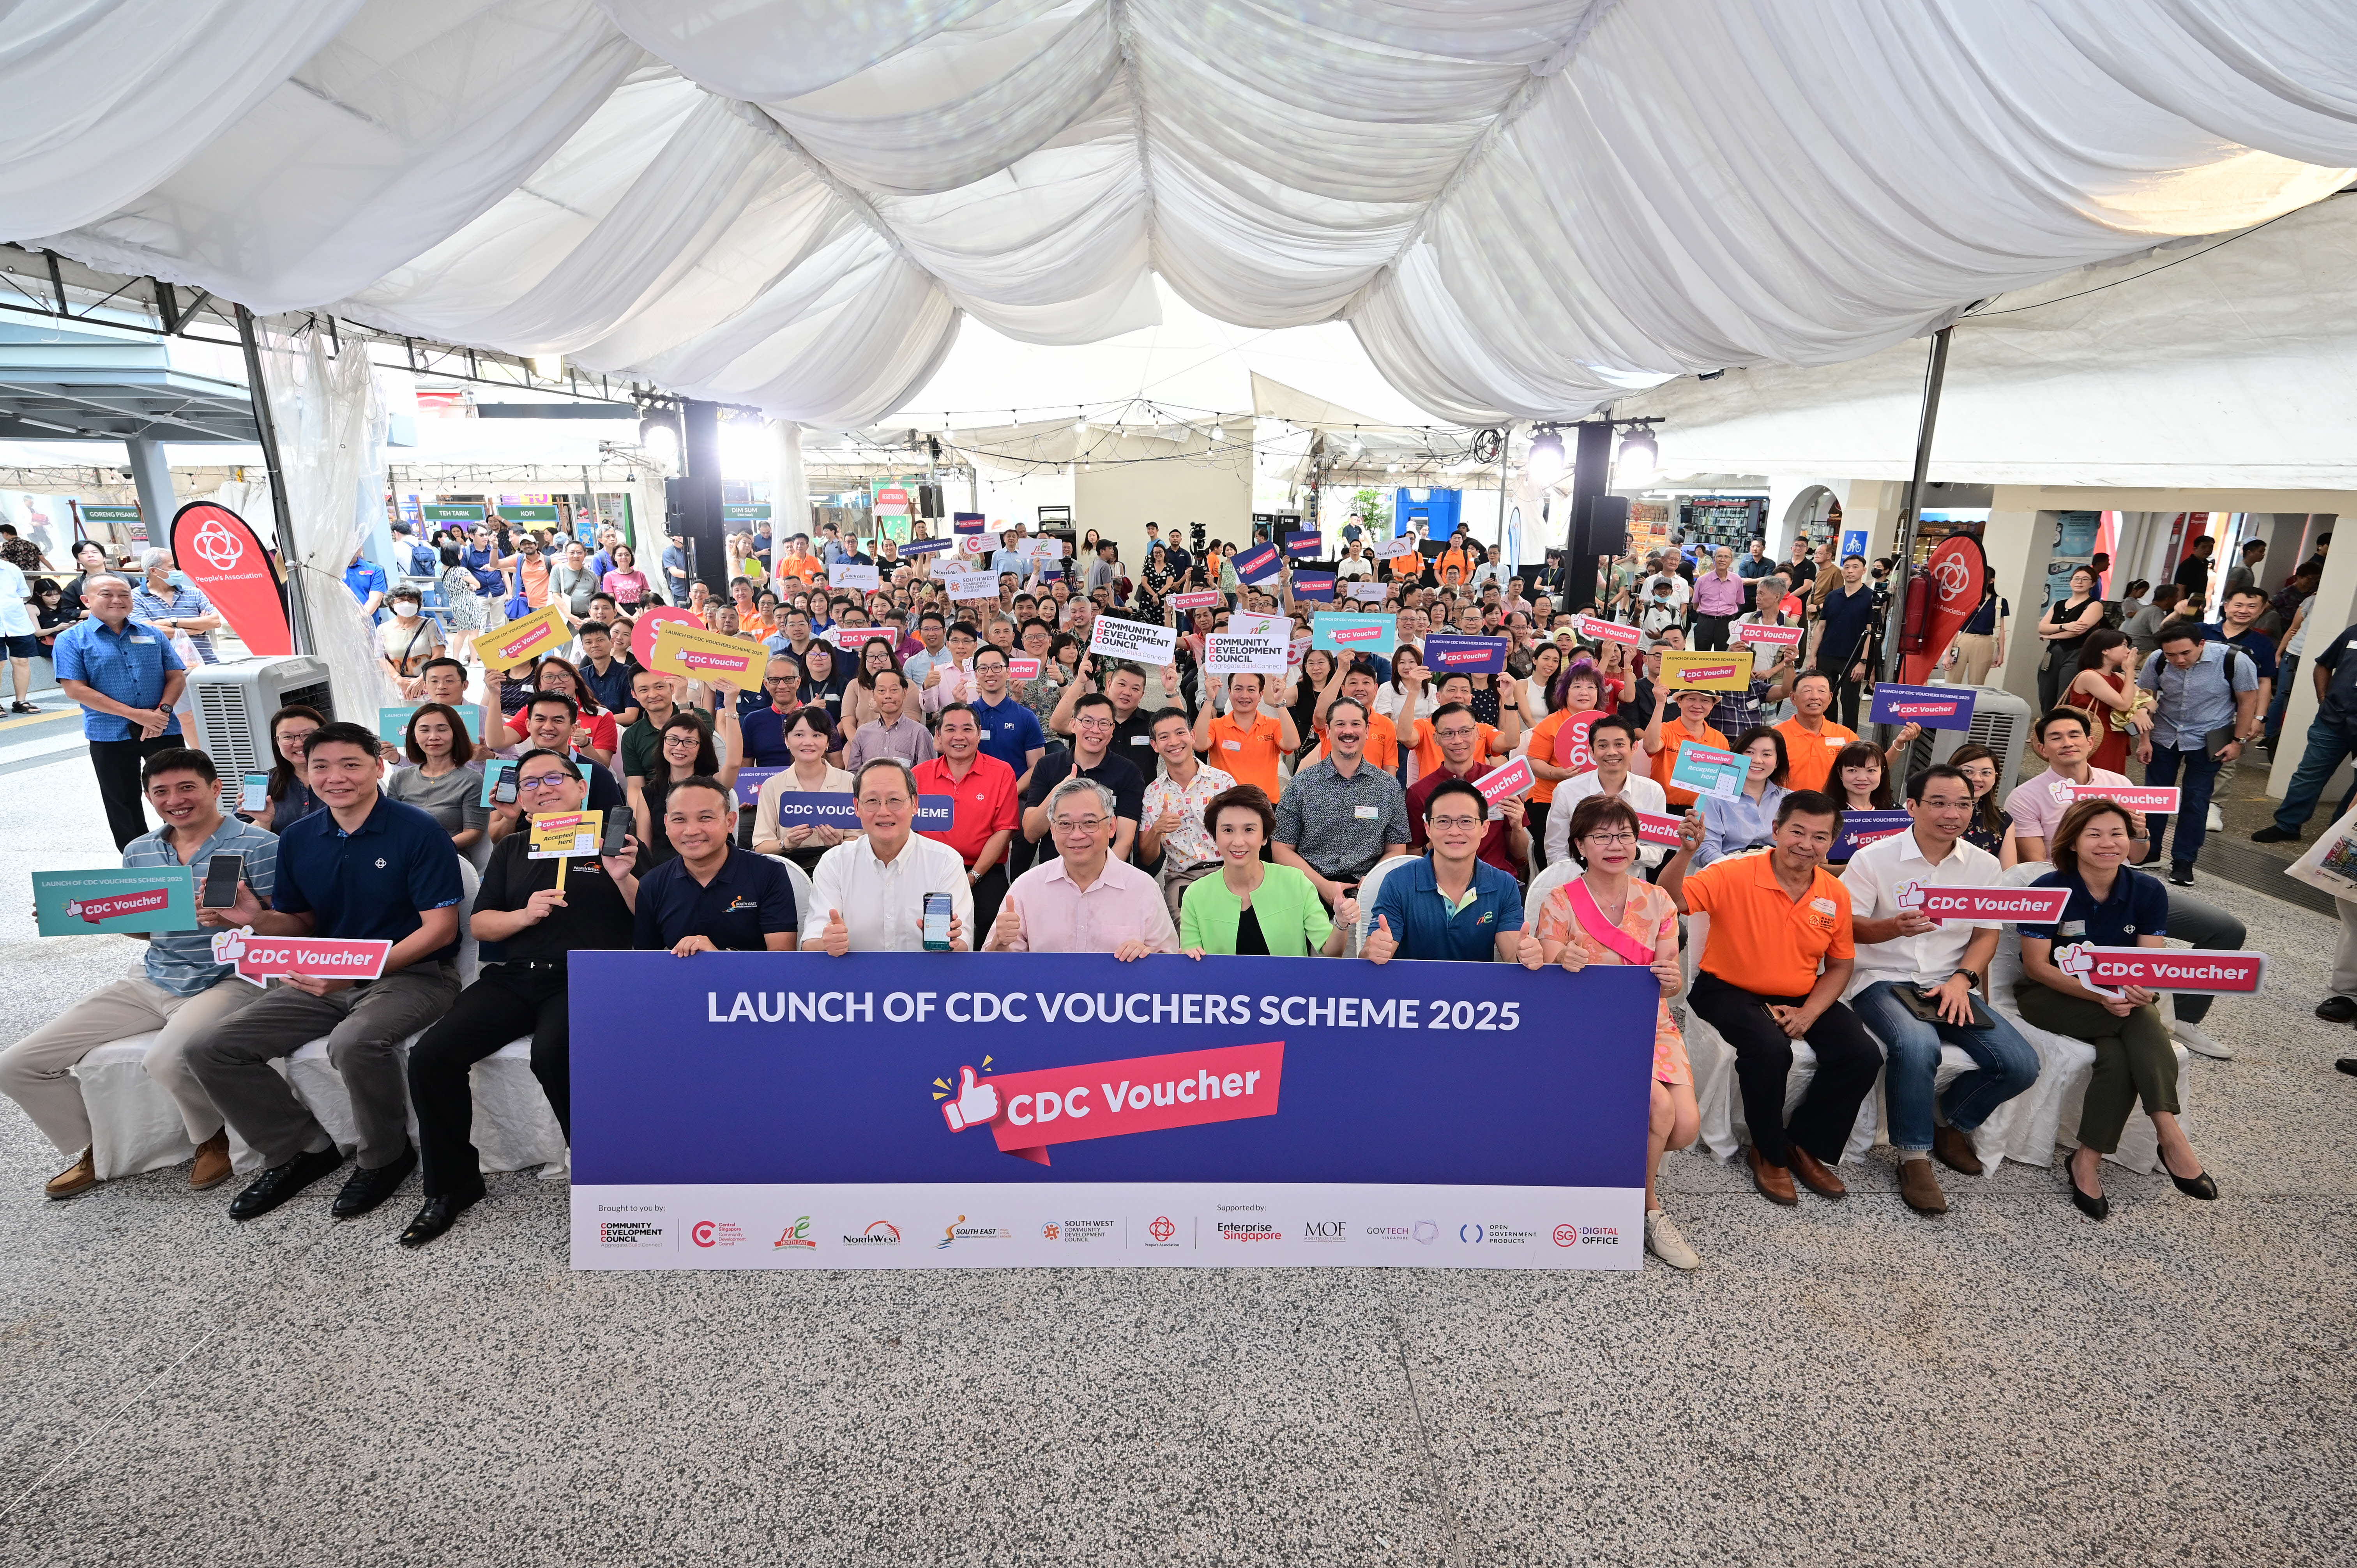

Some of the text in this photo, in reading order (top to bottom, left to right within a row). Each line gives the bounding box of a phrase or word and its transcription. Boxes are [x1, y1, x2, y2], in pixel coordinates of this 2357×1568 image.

[1255, 551, 1274, 566] Voucher
[195, 575, 223, 583] People's
[1191, 595, 1215, 603] Voucher
[479, 637, 495, 647] LAUNCH
[509, 622, 529, 634] VOUCHERS
[529, 615, 544, 625] SCHEME
[1098, 620, 1159, 637] COMMUNITY
[1585, 624, 1636, 639] CDC Voucher
[1763, 630, 1795, 639] Voucher
[508, 627, 547, 654] CDC Voucher
[665, 629, 686, 638] LAUNCH
[705, 639, 731, 649] VOUCHERS
[732, 645, 751, 653] SCHEME
[1095, 636, 1138, 650] COUNCIL
[1096, 628, 1170, 647] DEVELOPMENT
[1209, 646, 1282, 655] DEVELOPMENT
[688, 655, 744, 667] CDC Voucher
[1706, 754, 1730, 763] Voucher
[1687, 765, 1719, 774] Accepted
[2111, 794, 2169, 804] Voucher
[784, 805, 813, 814] CDC
[543, 832, 574, 841] Accepted
[85, 895, 162, 915] CDC Voucher
[1928, 897, 2052, 911] CDC Voucher
[248, 949, 373, 966] CDC Voucher
[2097, 962, 2248, 980] CDC Voucher
[708, 991, 1520, 1031] LAUNCH OF CDC VOUCHERS SCHEME 2025
[1007, 1069, 1260, 1127] CDC Voucher
[1218, 1222, 1272, 1233] Enterprise
[1305, 1221, 1346, 1237] MOF
[1223, 1230, 1282, 1242] Singapore
[1556, 1231, 1574, 1240] SG
